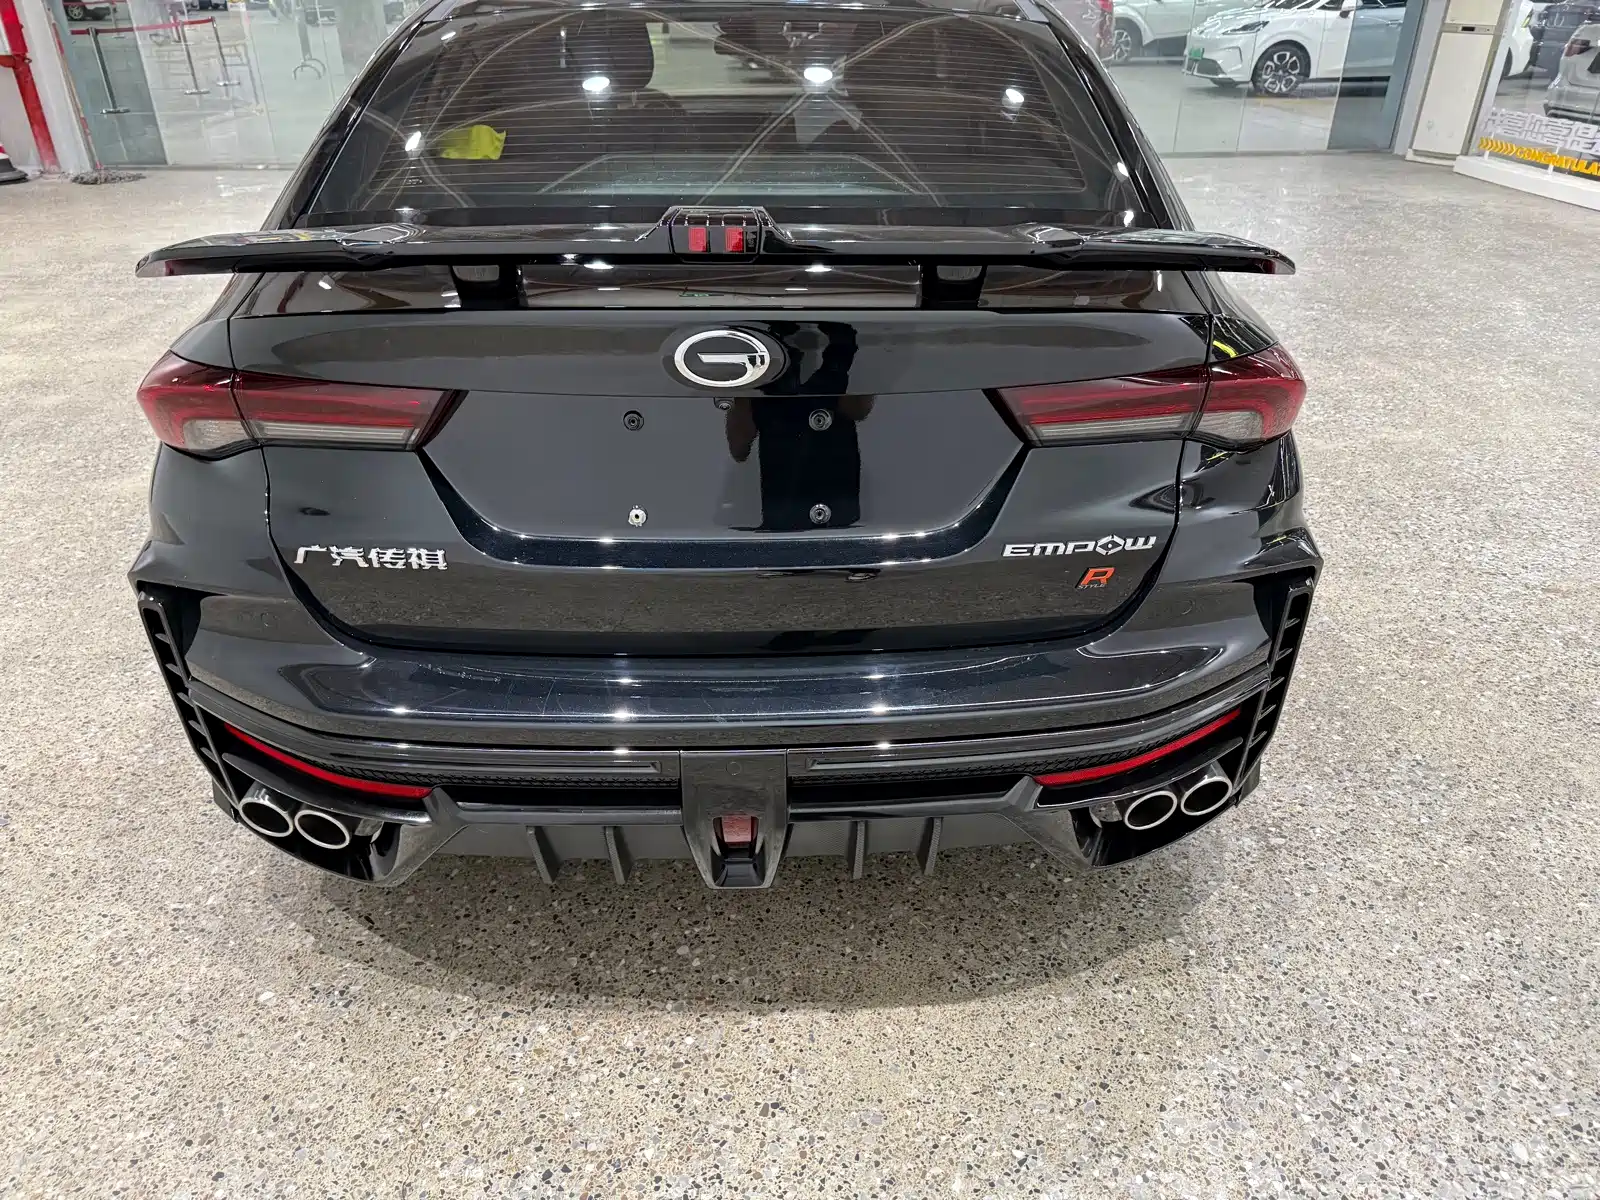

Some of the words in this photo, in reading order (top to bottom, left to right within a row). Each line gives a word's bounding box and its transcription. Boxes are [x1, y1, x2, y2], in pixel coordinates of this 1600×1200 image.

[1483, 108, 1600, 156] 恭喜您喜提
[1516, 146, 1600, 176] CONGRATULA
[294, 544, 448, 570] 广汽传祺
[1002, 534, 1157, 557] EMPOW
[1080, 567, 1115, 585] R
